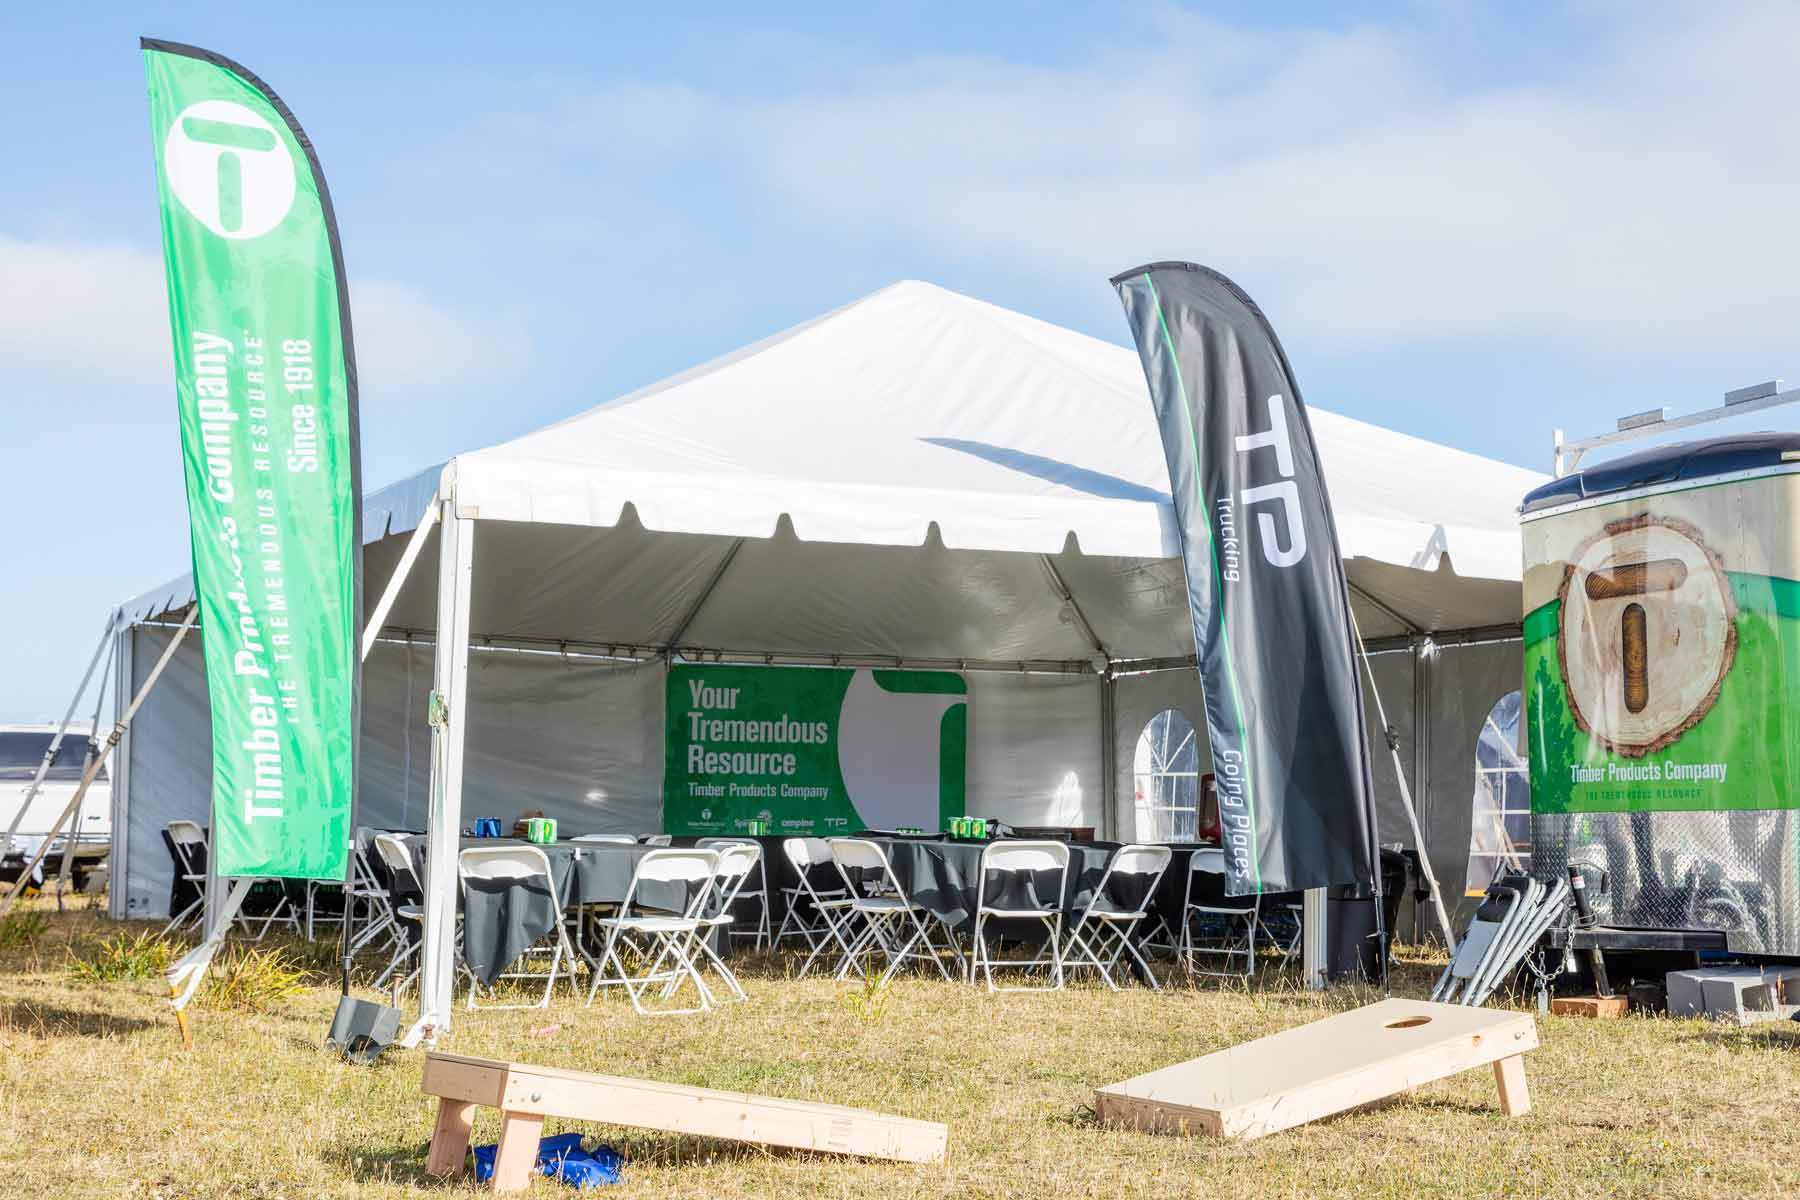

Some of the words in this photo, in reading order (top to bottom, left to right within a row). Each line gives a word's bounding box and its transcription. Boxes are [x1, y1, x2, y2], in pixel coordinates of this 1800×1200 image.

[283, 339, 314, 393] 1918
[192, 331, 239, 502] Company
[244, 336, 271, 471] RESOURCE
[288, 404, 319, 473] Since
[1235, 394, 1306, 567] TP
[1217, 493, 1240, 582] Trucking
[220, 516, 270, 678] Prodts
[256, 489, 294, 663] TREMENDOUS
[687, 712, 828, 744] Tremendous
[688, 679, 741, 709] Your
[243, 688, 284, 824] Timber
[687, 745, 796, 775] Resource
[1223, 750, 1245, 807] Going
[1570, 764, 1606, 783] Timber
[1608, 762, 1661, 781] Products
[1665, 760, 1727, 783] Company
[687, 782, 725, 797] Timber
[729, 783, 776, 798] Products
[780, 783, 828, 800] Company
[1232, 815, 1251, 883] Places.
